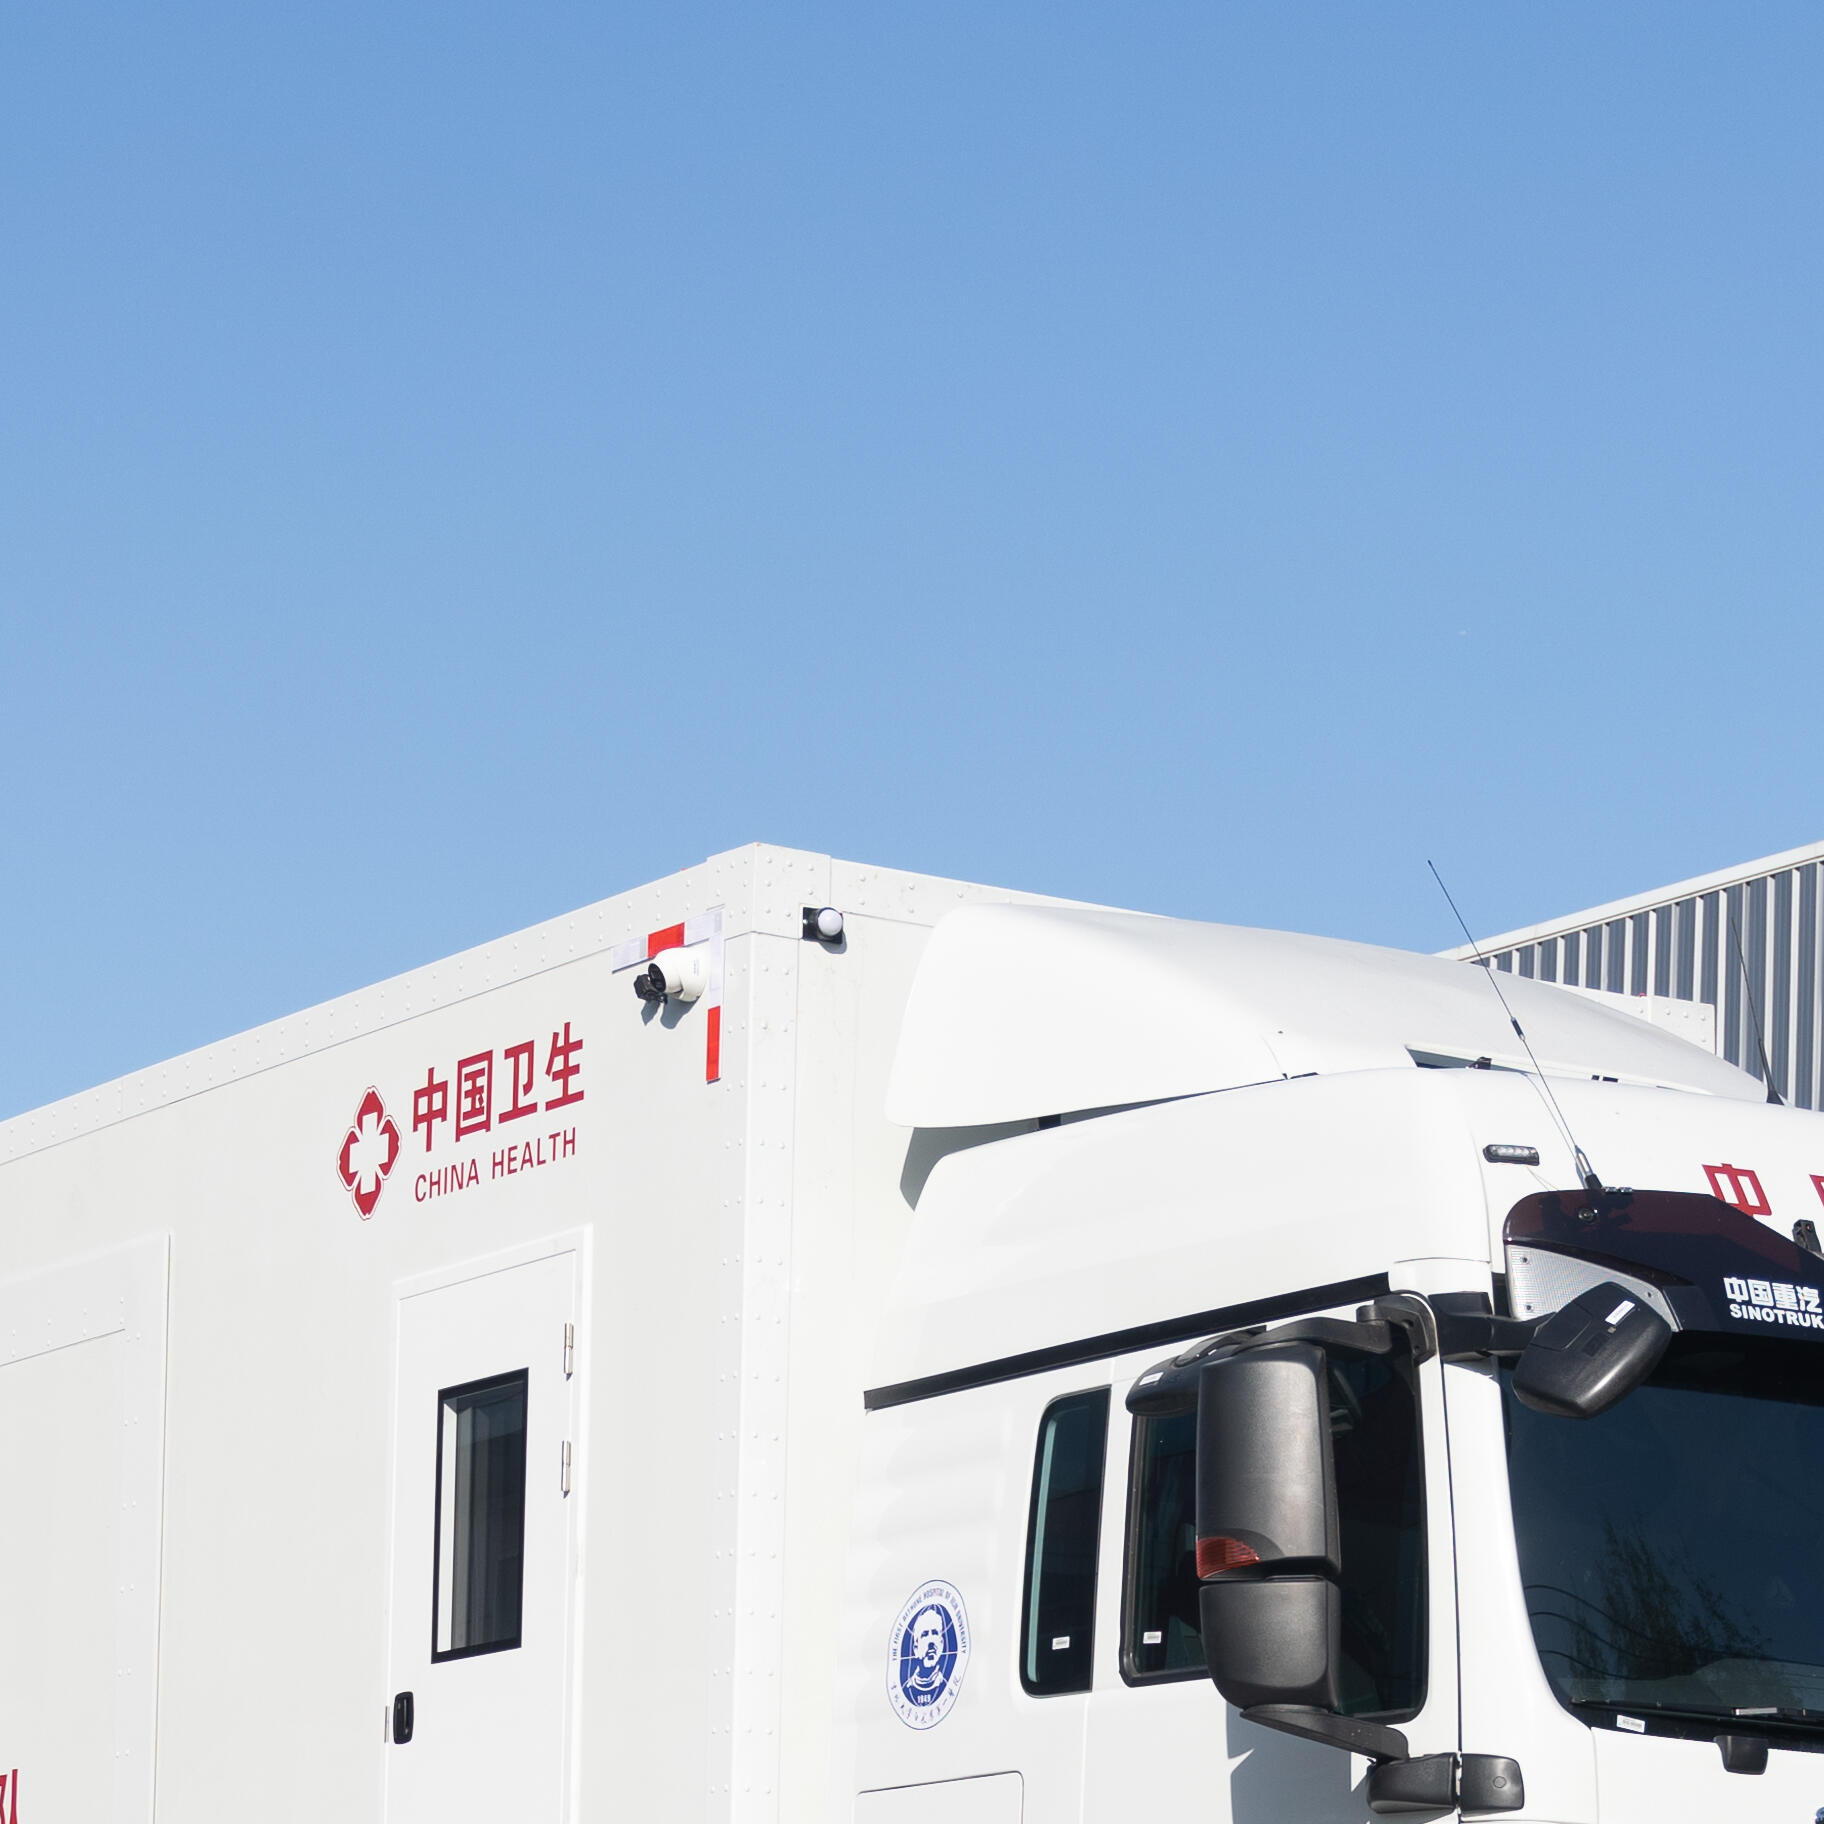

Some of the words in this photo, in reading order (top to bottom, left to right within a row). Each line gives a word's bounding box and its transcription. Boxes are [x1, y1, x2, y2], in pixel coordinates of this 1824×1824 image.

[413, 1021, 584, 1153] 中国卫生
[414, 1158, 479, 1203] CHINA
[491, 1126, 576, 1180] HEALTH
[1723, 1276, 1823, 1314] 中国重汽
